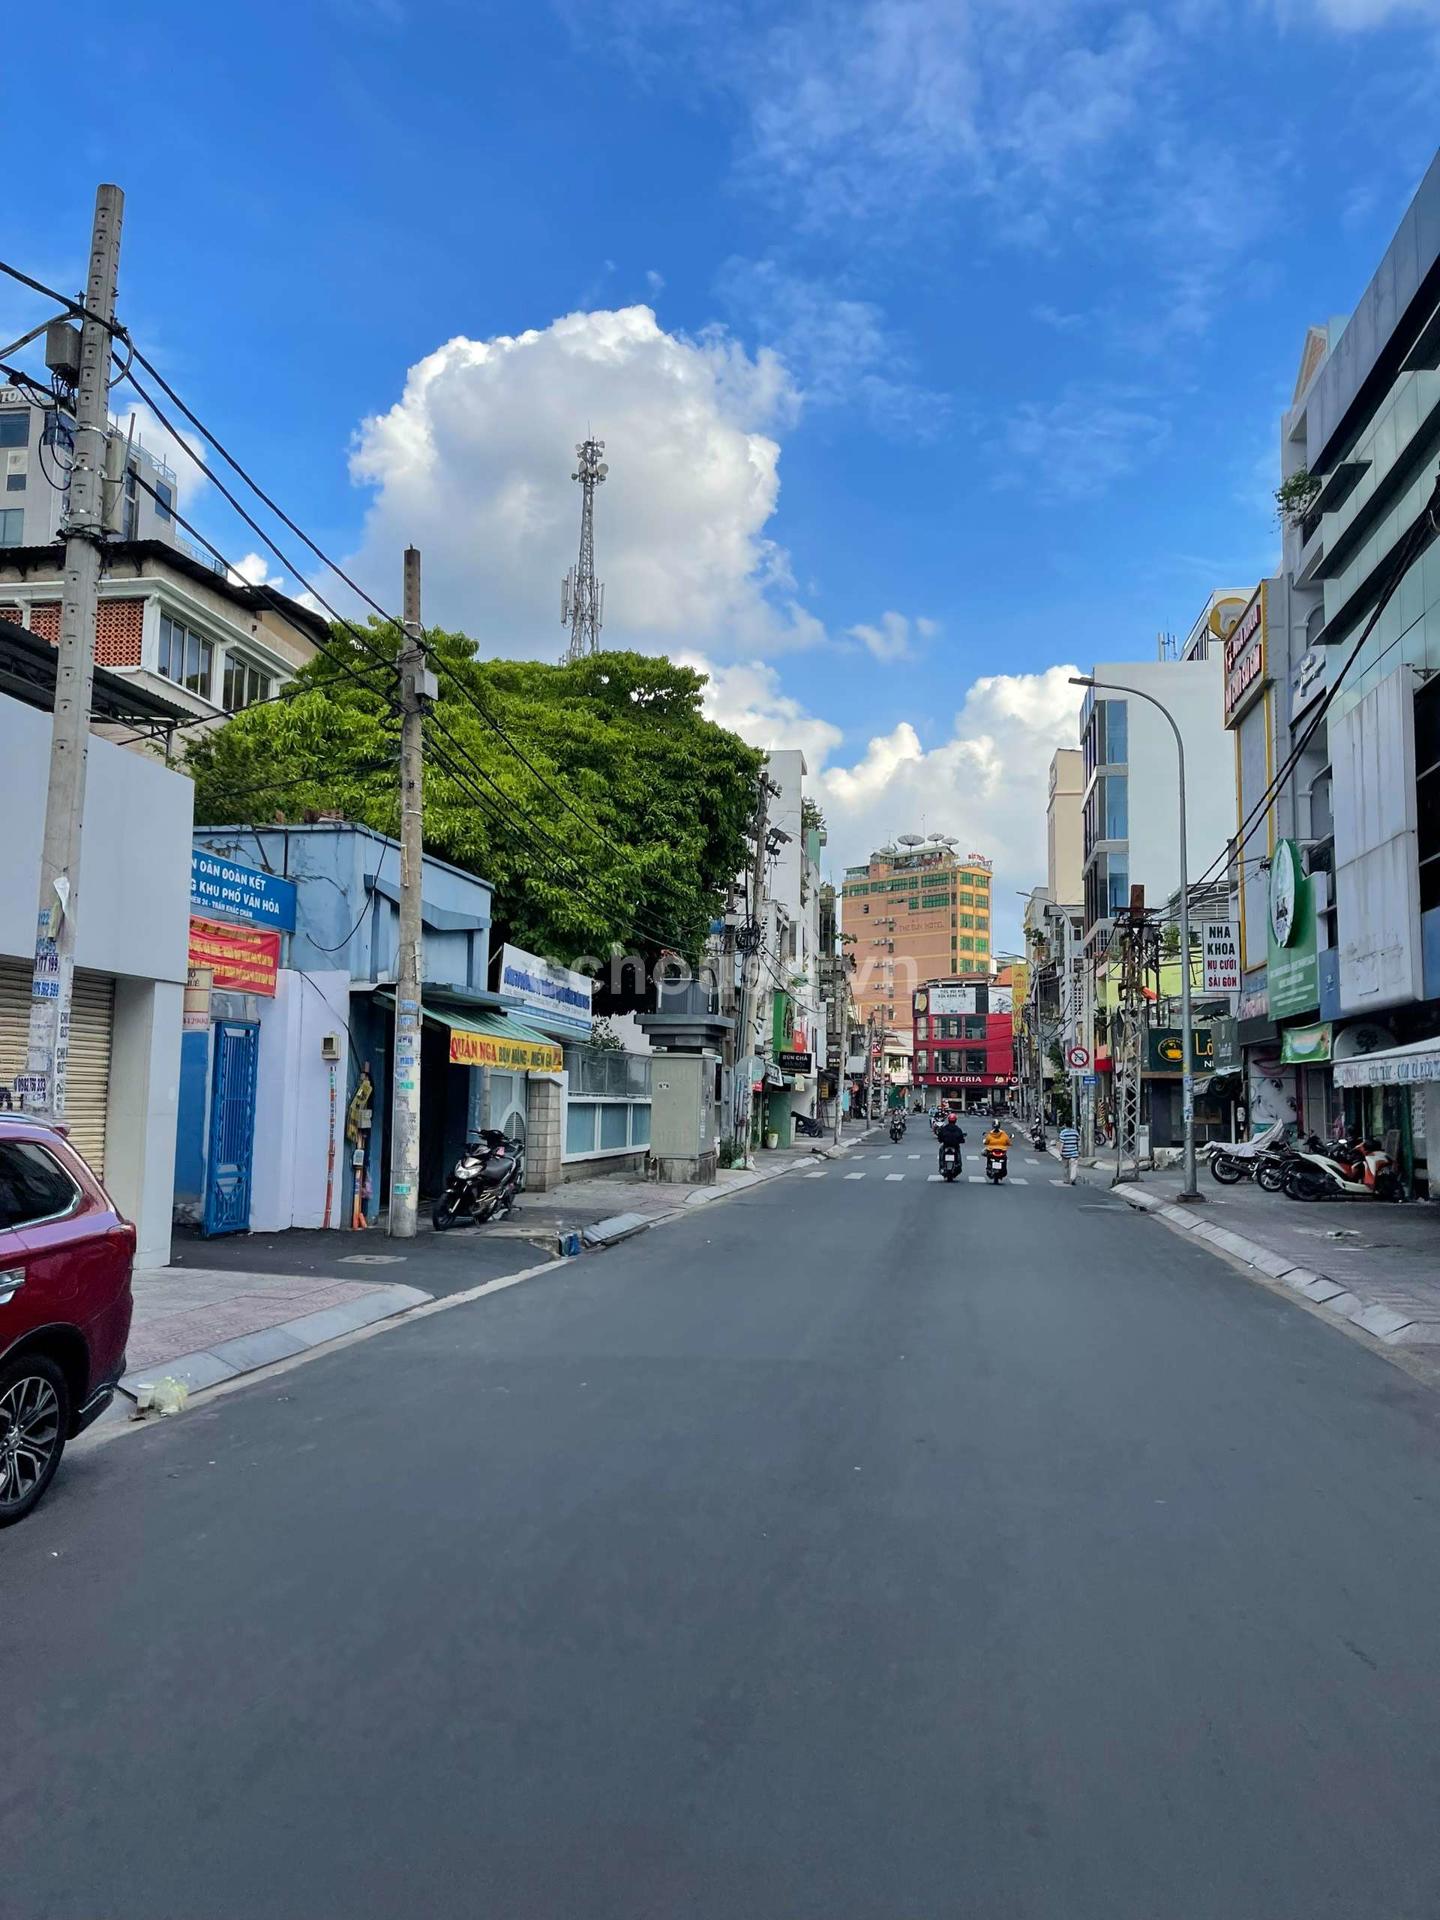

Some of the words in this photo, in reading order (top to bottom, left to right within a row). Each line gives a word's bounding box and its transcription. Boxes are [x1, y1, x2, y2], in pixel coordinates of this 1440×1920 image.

[200, 859, 220, 877] DÂN
[222, 868, 248, 885] ĐOÀN
[249, 875, 266, 891] KẾT
[200, 880, 220, 897] KHU
[222, 887, 242, 902] PHỐ
[243, 892, 261, 909] VĂN
[1209, 926, 1231, 938] NHA
[1207, 943, 1235, 955] KHOA
[1207, 959, 1218, 972] NỤ
[1208, 974, 1220, 987] SÀI
[1222, 974, 1237, 987] GÒN
[450, 1034, 477, 1060] QUÁN
[480, 1042, 497, 1062] NGA
[936, 1075, 982, 1083] LOTTERIA
